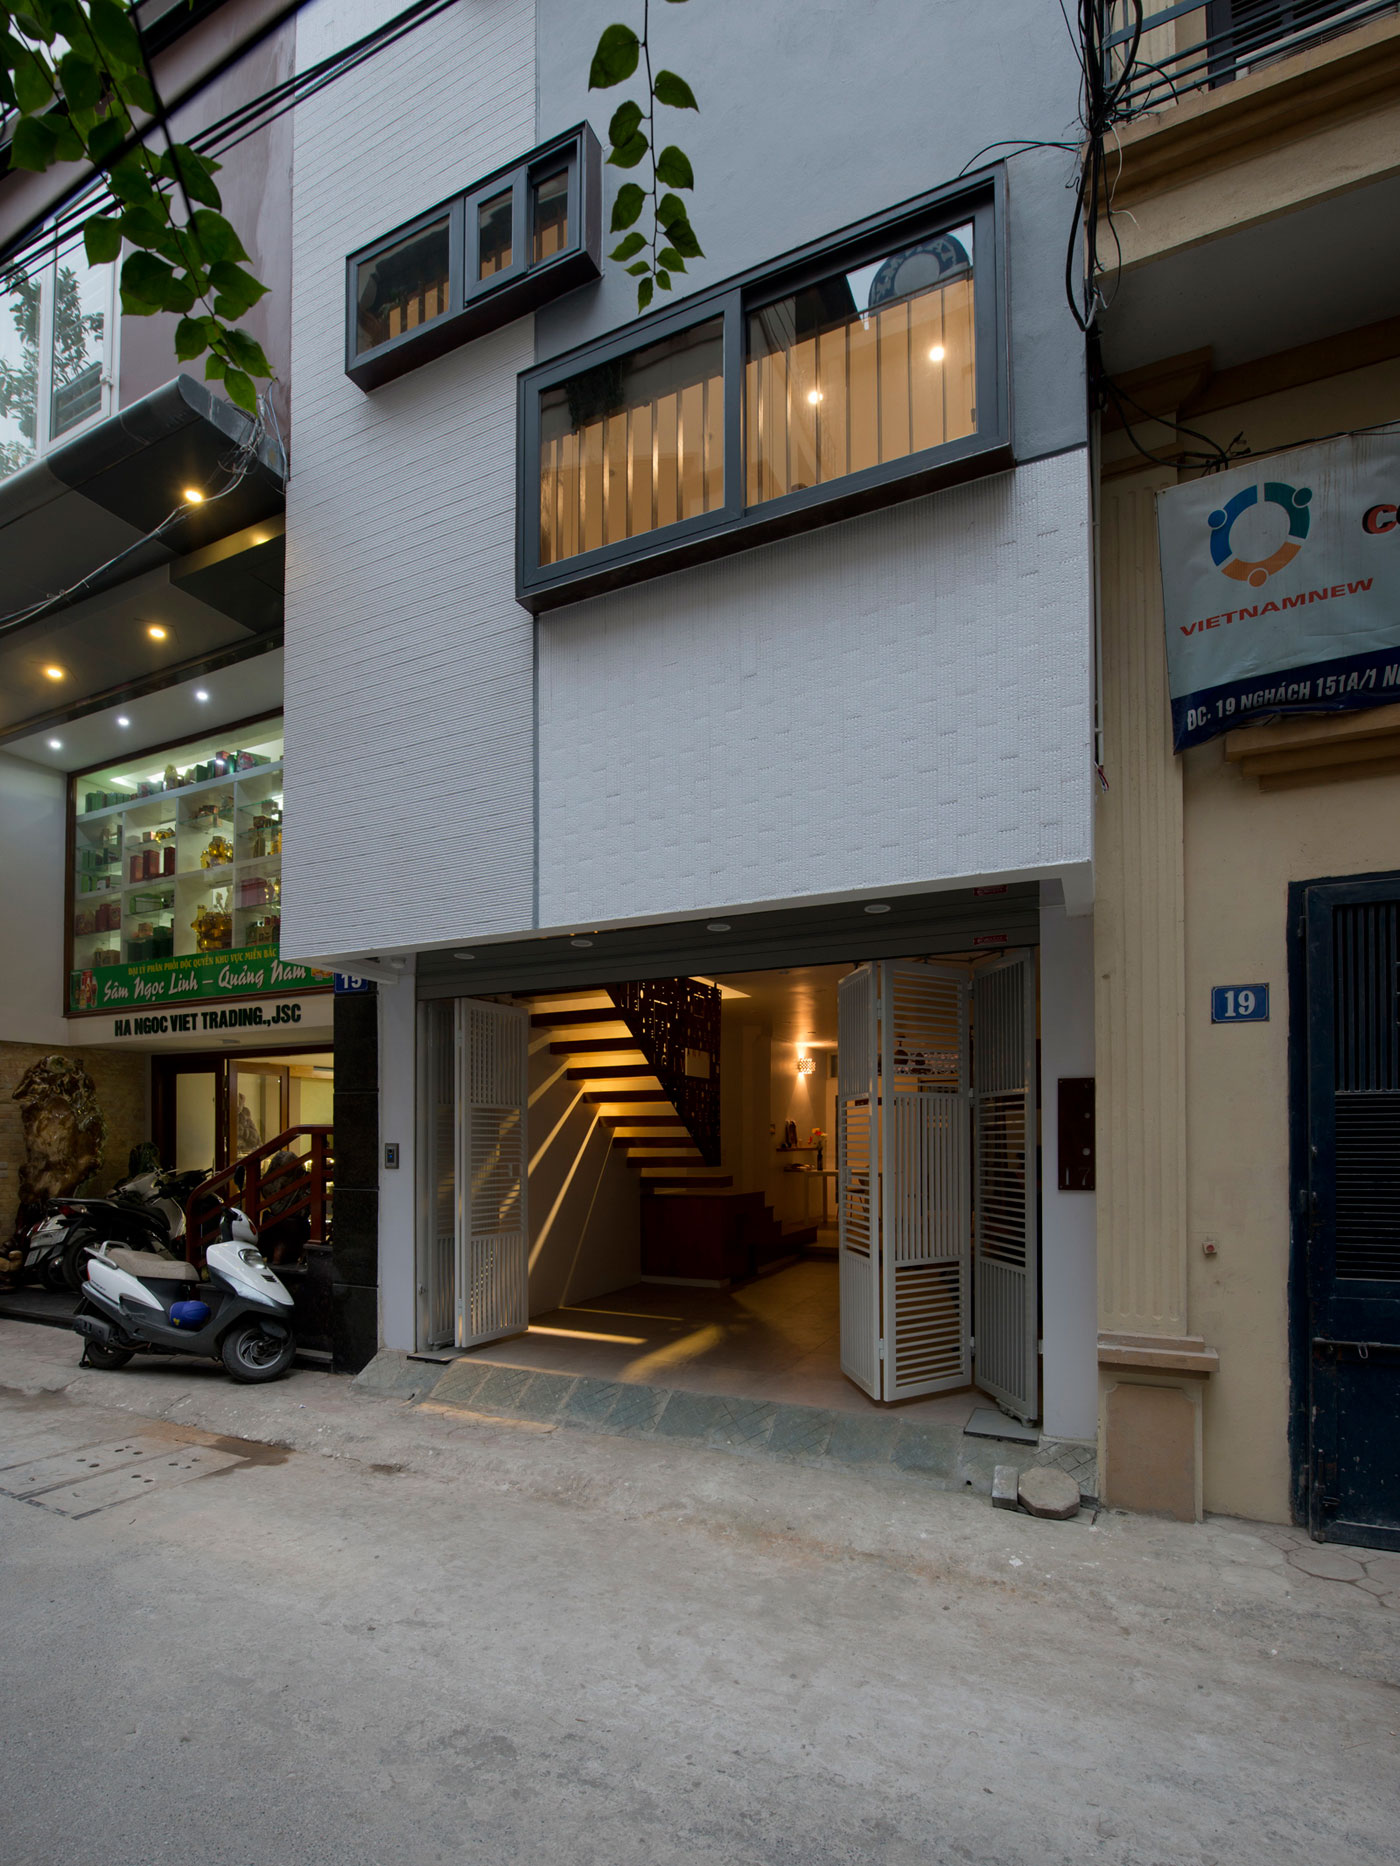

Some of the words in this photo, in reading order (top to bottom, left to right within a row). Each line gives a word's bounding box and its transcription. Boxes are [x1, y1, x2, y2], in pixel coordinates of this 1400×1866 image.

[1362, 504, 1400, 535] C
[1180, 578, 1374, 637] VIETNAMNEW
[1216, 697, 1236, 718] 19
[1240, 681, 1311, 708] NGHÁCH
[1316, 667, 1377, 698] 151A/1
[103, 979, 129, 1002] Sâm
[134, 975, 165, 1001] Ngọc
[168, 970, 199, 995] Linh
[218, 964, 265, 990] Quảng
[270, 959, 307, 985] Nam
[1224, 990, 1256, 1018] 19
[114, 1018, 132, 1036] HA
[134, 1015, 168, 1035] NGOC
[170, 1012, 198, 1032] VIET
